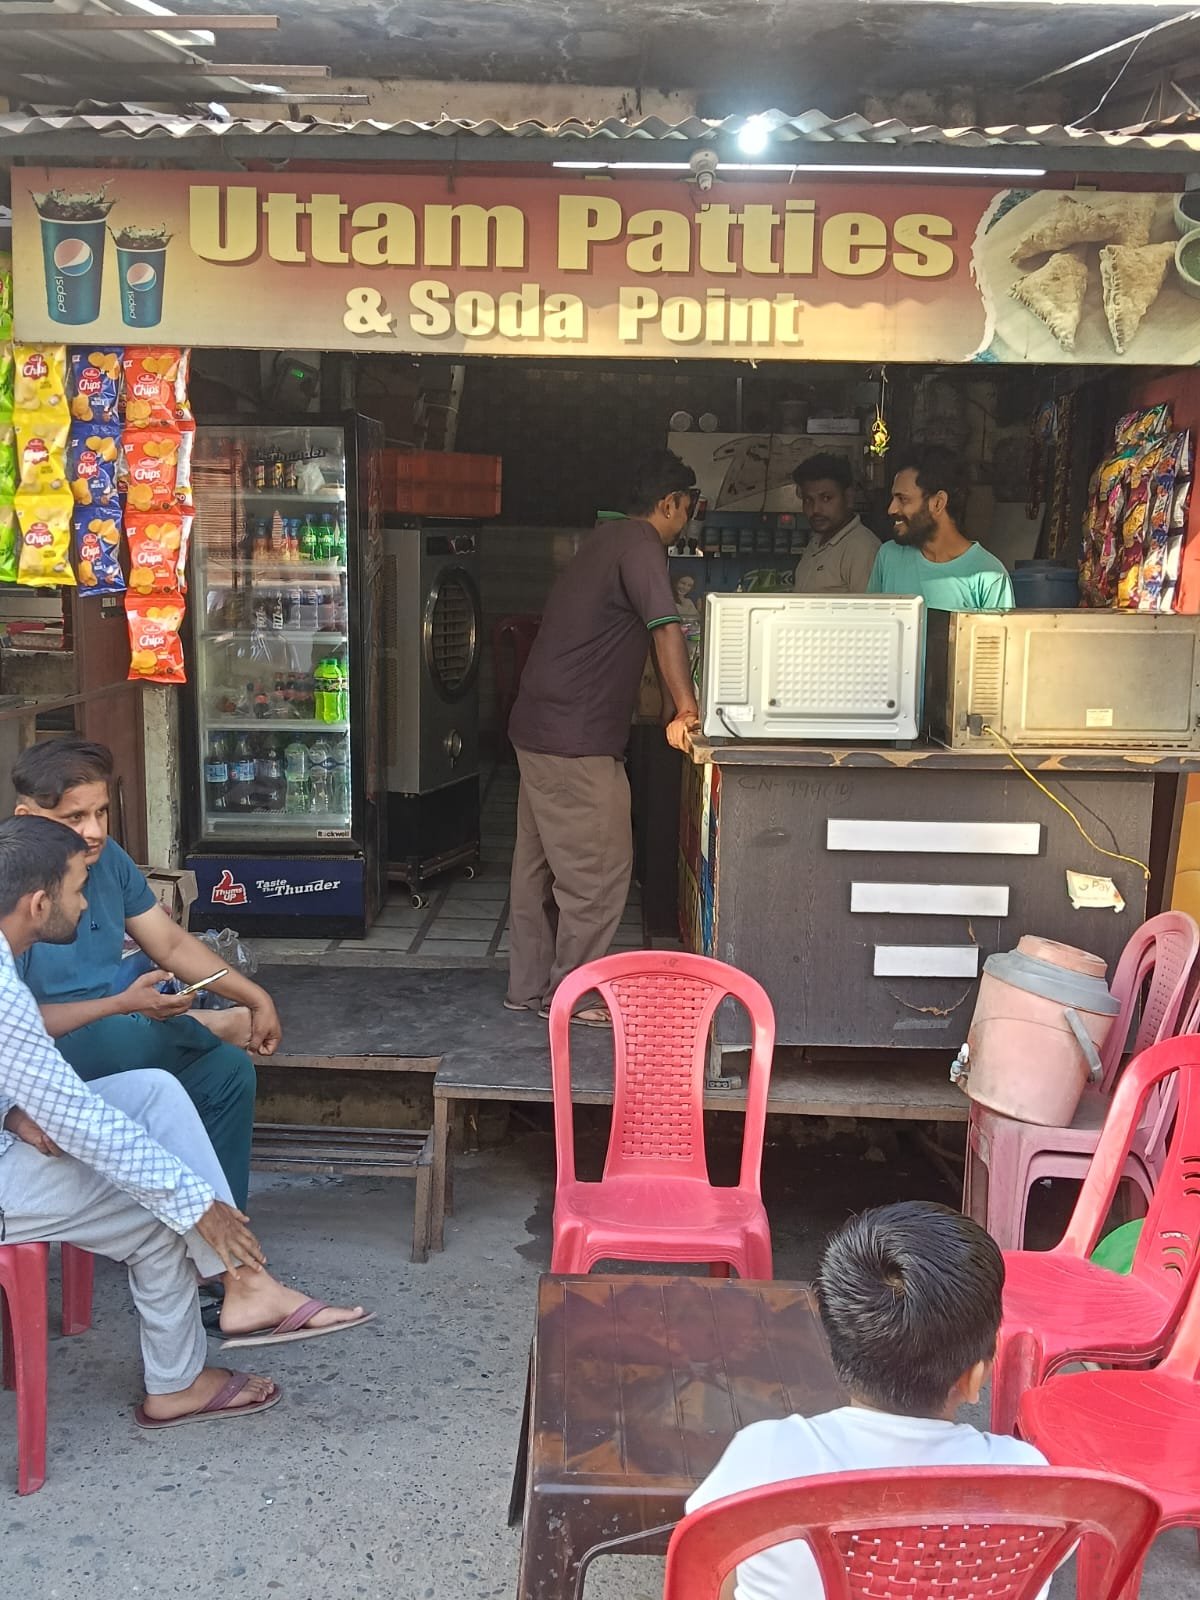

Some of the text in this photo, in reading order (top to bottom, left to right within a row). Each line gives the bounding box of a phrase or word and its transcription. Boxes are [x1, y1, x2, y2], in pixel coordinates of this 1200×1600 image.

[189, 185, 955, 277] Uttam Patties
[55, 276, 67, 313] pepsi
[127, 291, 137, 319] pepsi
[343, 280, 800, 343] & Soda Point
[79, 379, 101, 392] Chips
[133, 384, 160, 397] Chips
[78, 463, 98, 475] Chips
[134, 468, 161, 481] Chips
[25, 533, 52, 546] Chips
[137, 552, 163, 565] Chips
[139, 635, 165, 648] Chips
[256, 879, 287, 889] Taste
[273, 880, 341, 896] Thunder
[215, 887, 243, 897] Thums
